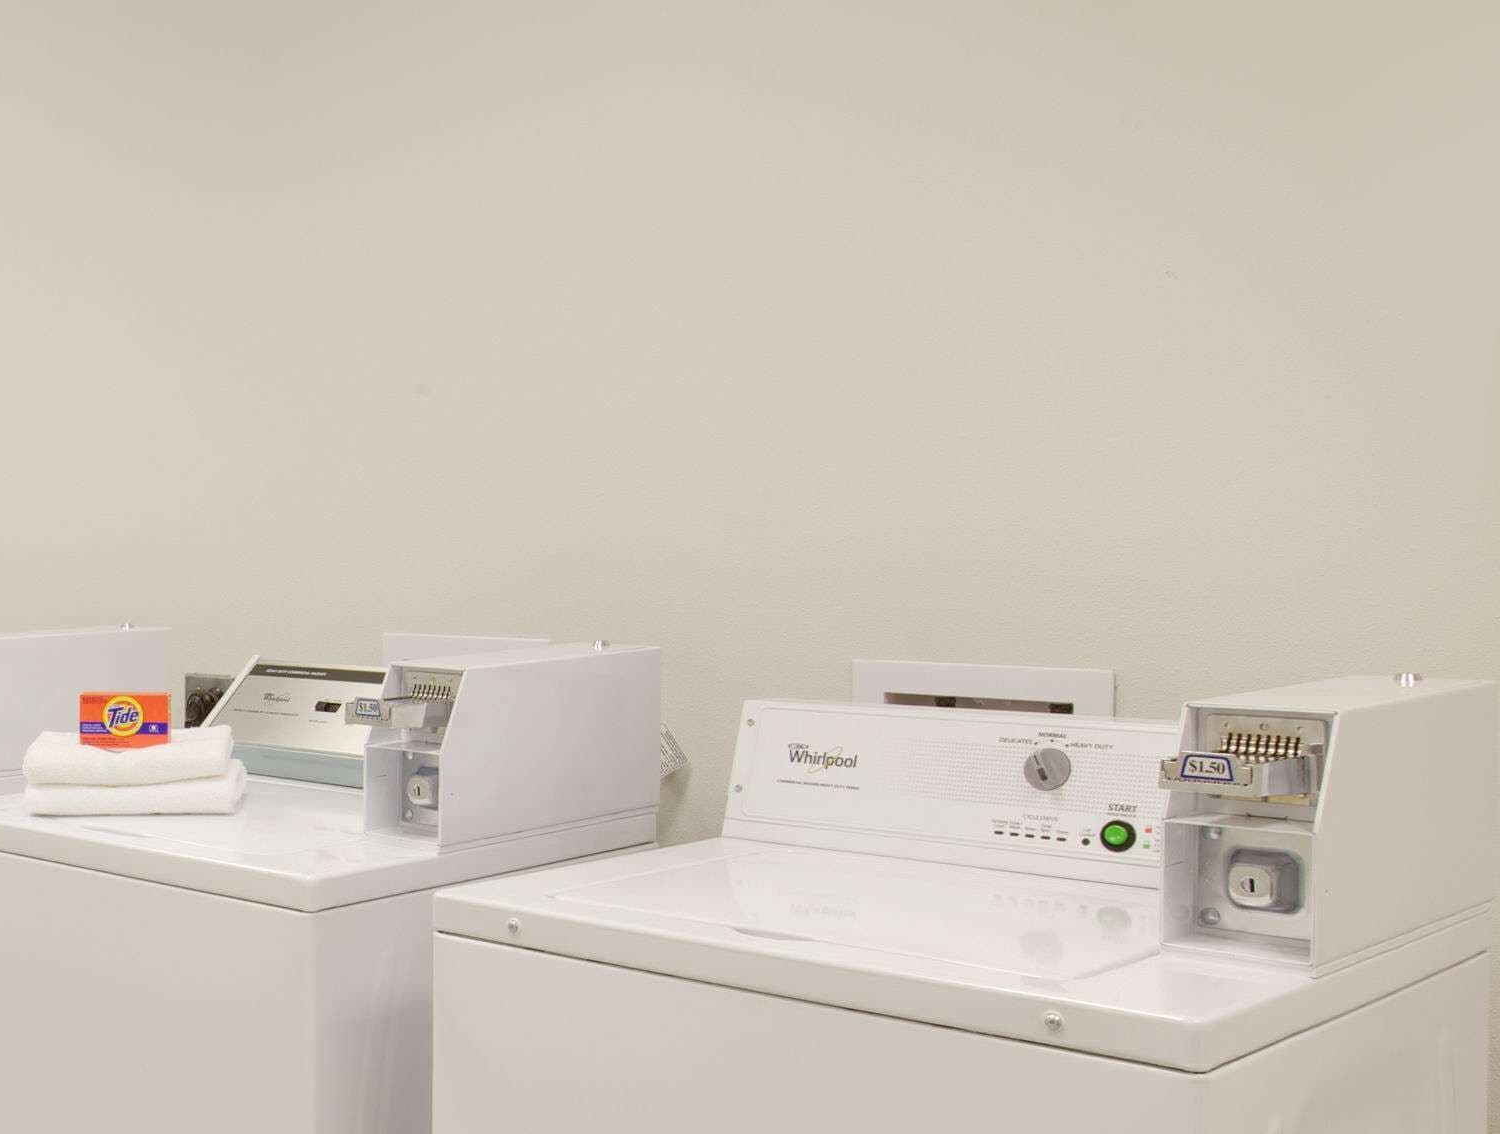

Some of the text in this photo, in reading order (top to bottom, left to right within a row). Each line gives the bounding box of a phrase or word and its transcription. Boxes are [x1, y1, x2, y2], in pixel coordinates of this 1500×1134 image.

[358, 702, 379, 713] $1.50
[107, 705, 139, 728] Tide
[998, 737, 1033, 745] DELICATES
[788, 749, 858, 770] Whirlpool
[1188, 759, 1226, 775] $1.50
[1107, 803, 1138, 813] START
